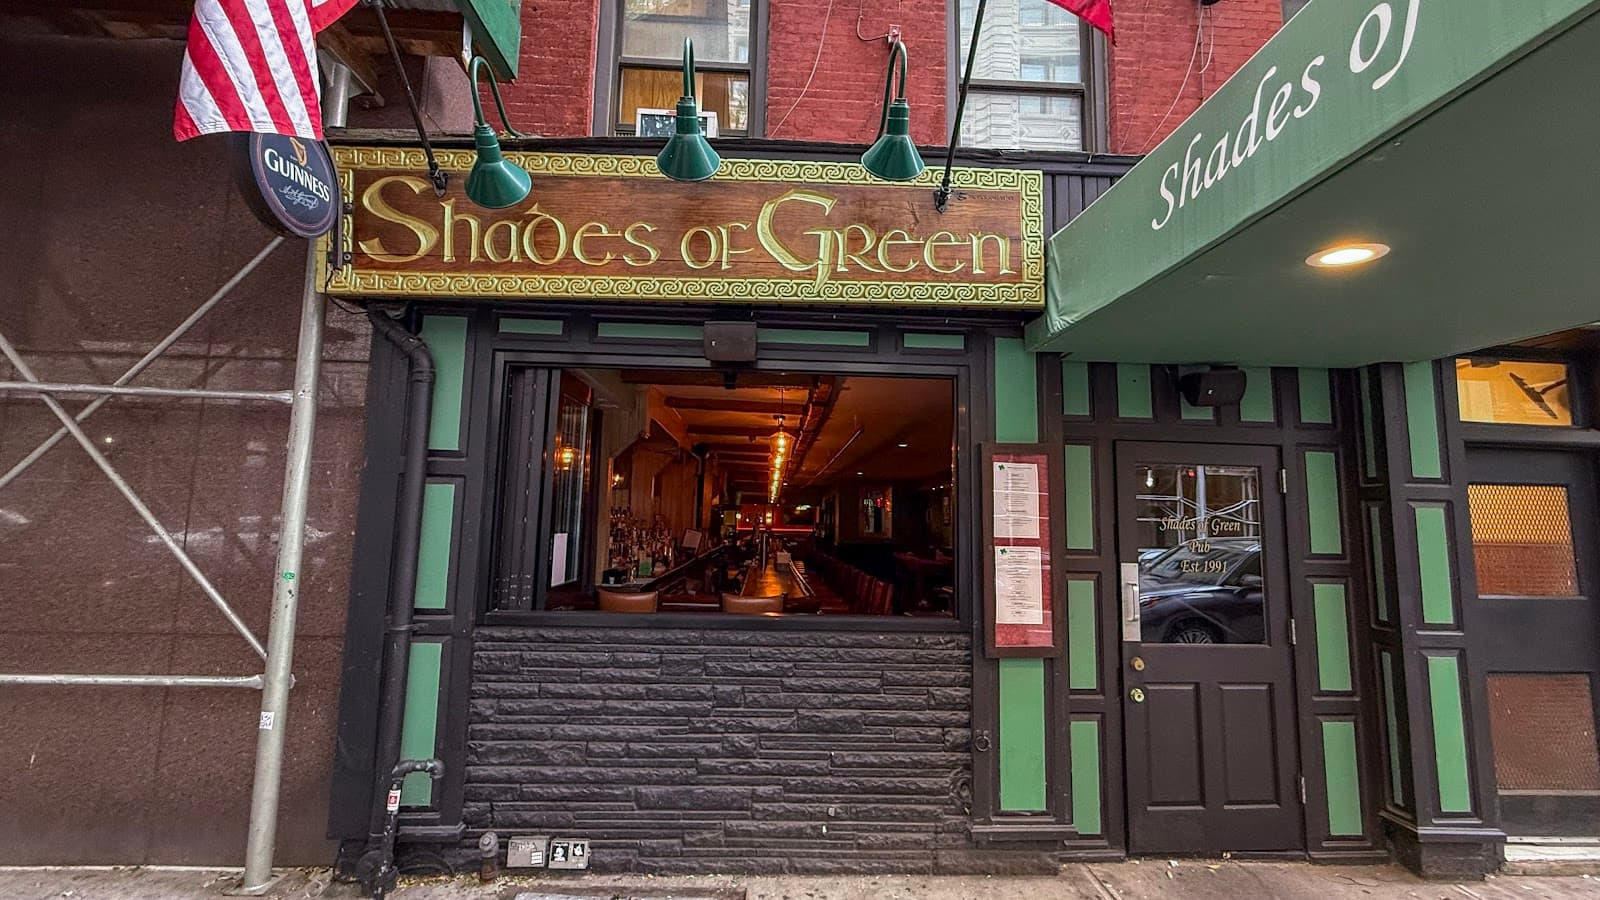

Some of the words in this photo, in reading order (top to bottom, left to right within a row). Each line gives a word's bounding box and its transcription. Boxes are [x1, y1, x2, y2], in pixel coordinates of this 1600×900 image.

[1151, 55, 1325, 230] Shades
[264, 148, 330, 202] GUINNESS
[358, 175, 661, 266] Shades
[1160, 516, 1195, 531] Shades
[1197, 516, 1210, 532] of
[1211, 518, 1240, 535] Green
[1189, 540, 1210, 553] Pub
[1181, 560, 1199, 573] Est
[1204, 560, 1227, 573] 1991
